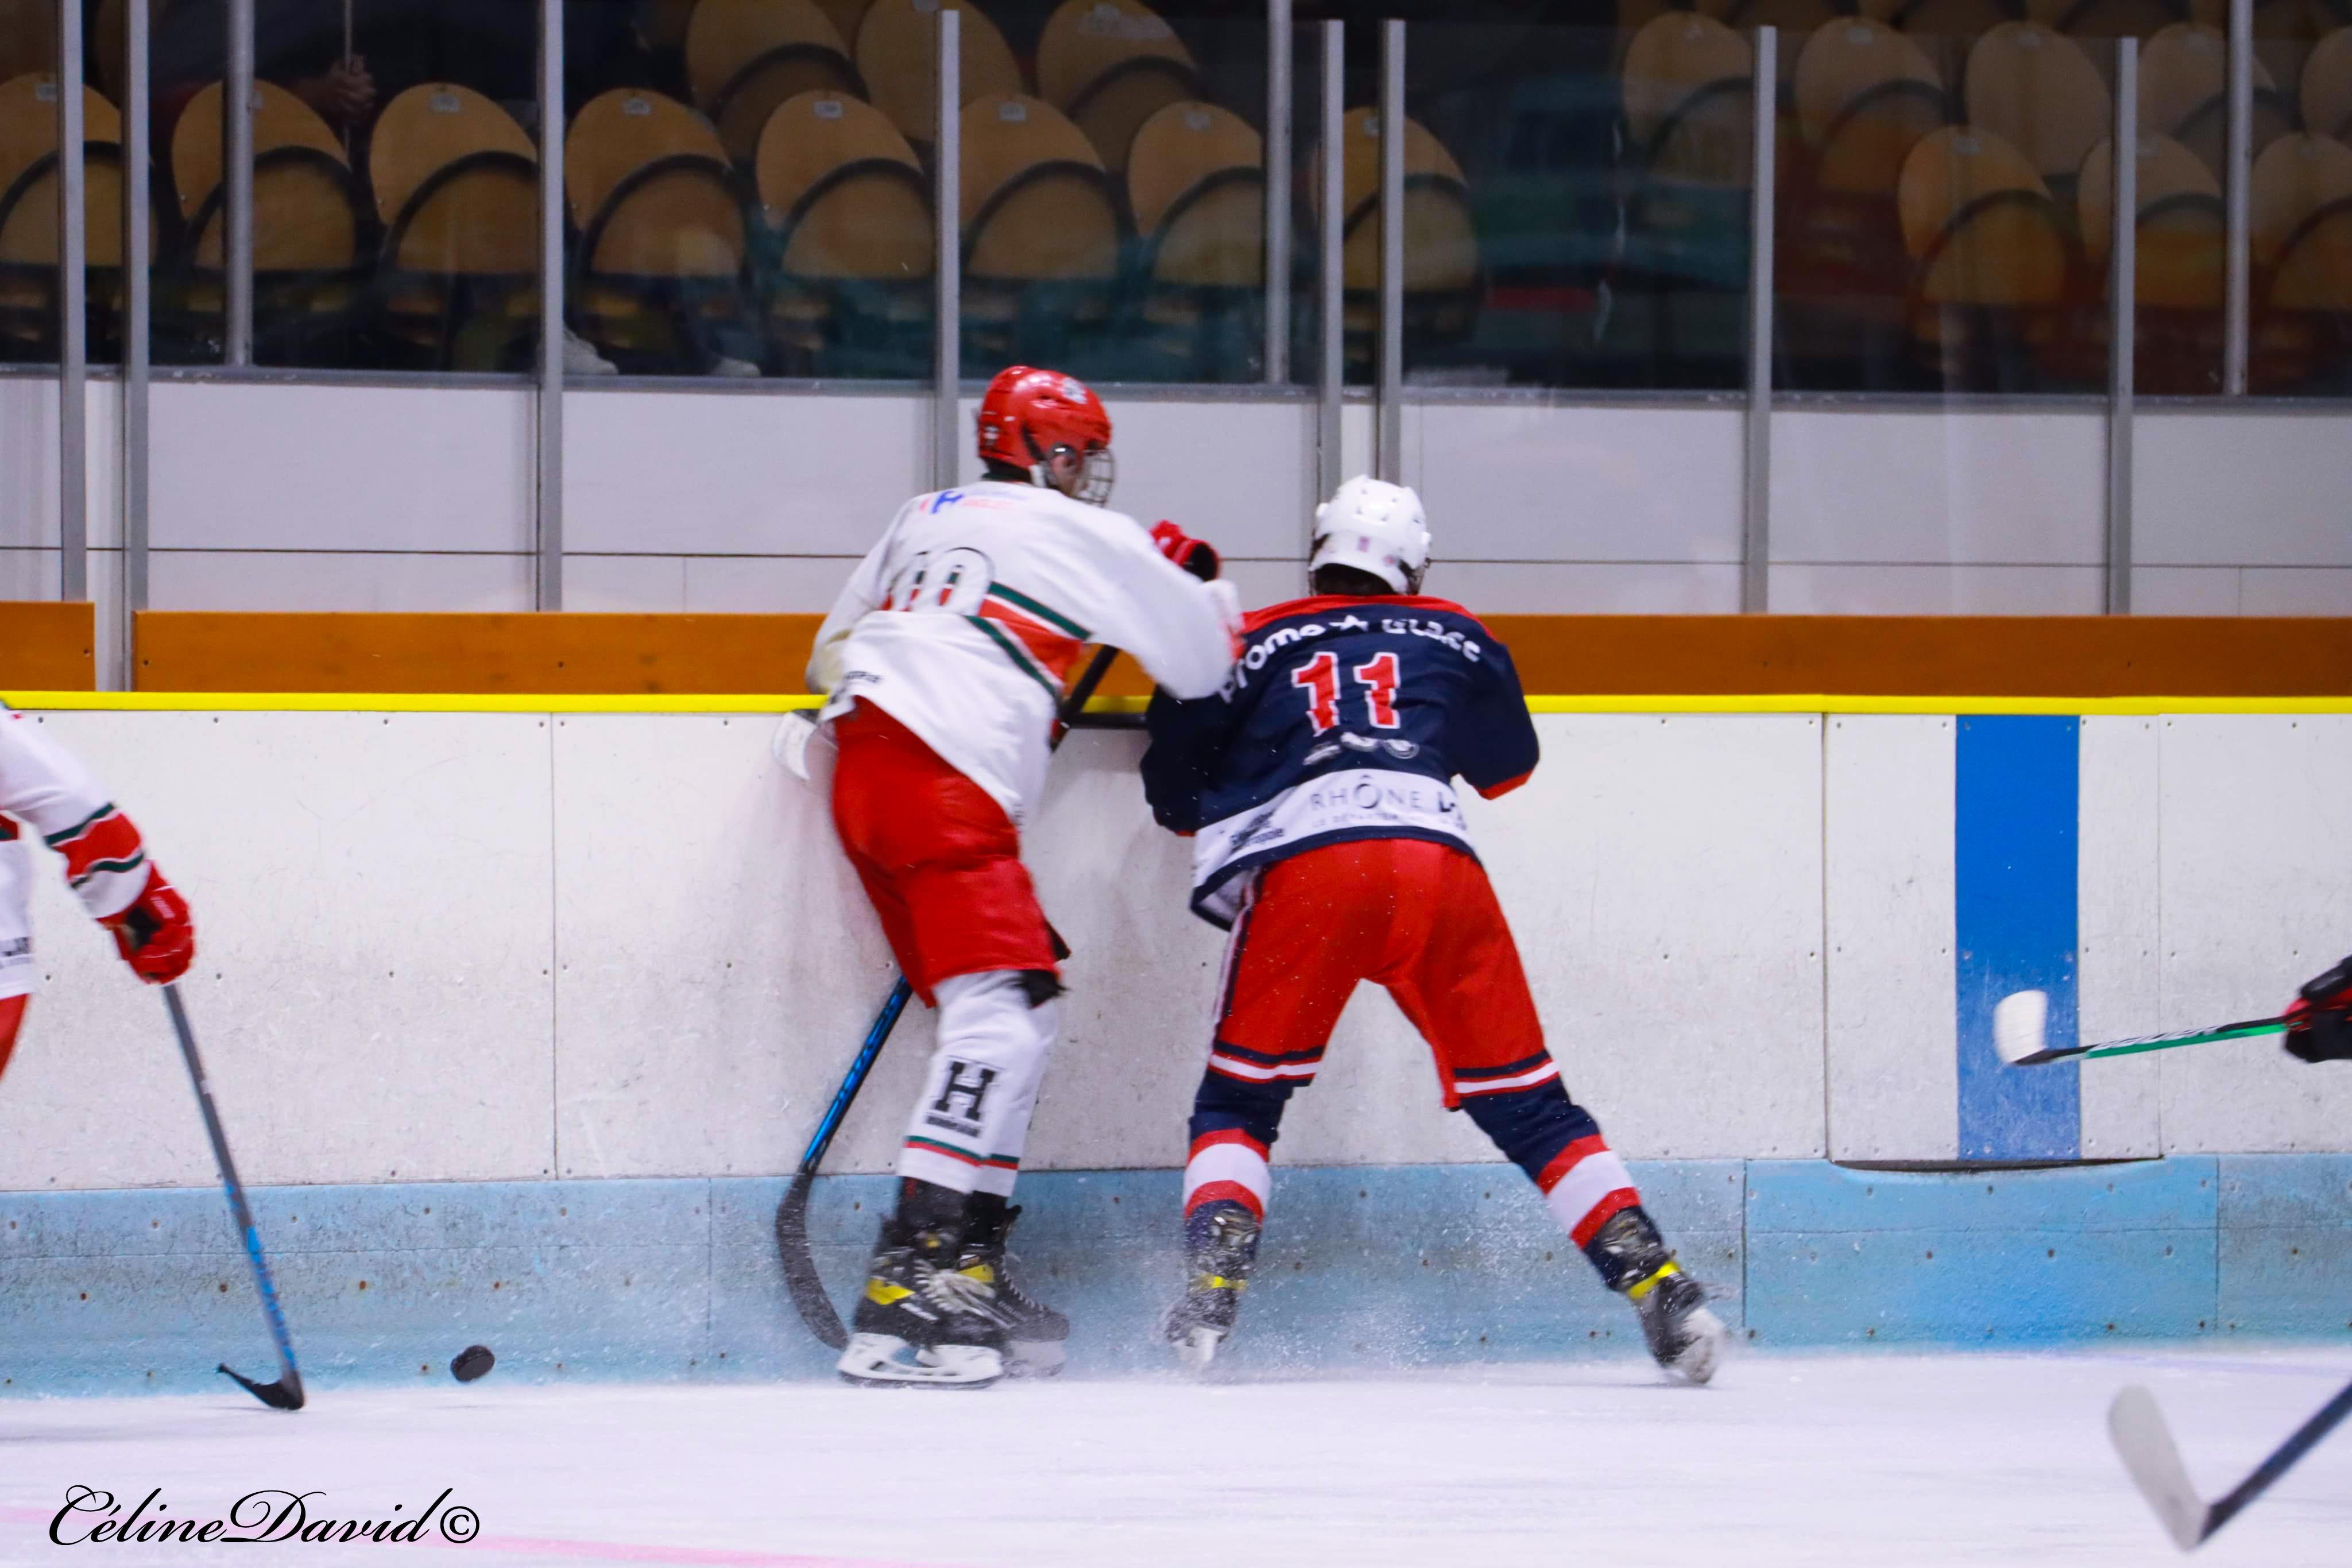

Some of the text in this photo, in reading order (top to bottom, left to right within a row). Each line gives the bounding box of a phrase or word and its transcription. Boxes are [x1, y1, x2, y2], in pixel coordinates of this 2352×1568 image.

[1291, 651, 1401, 737] 11
[1309, 774, 1422, 811] RHÔNE
[931, 1060, 998, 1122] H
